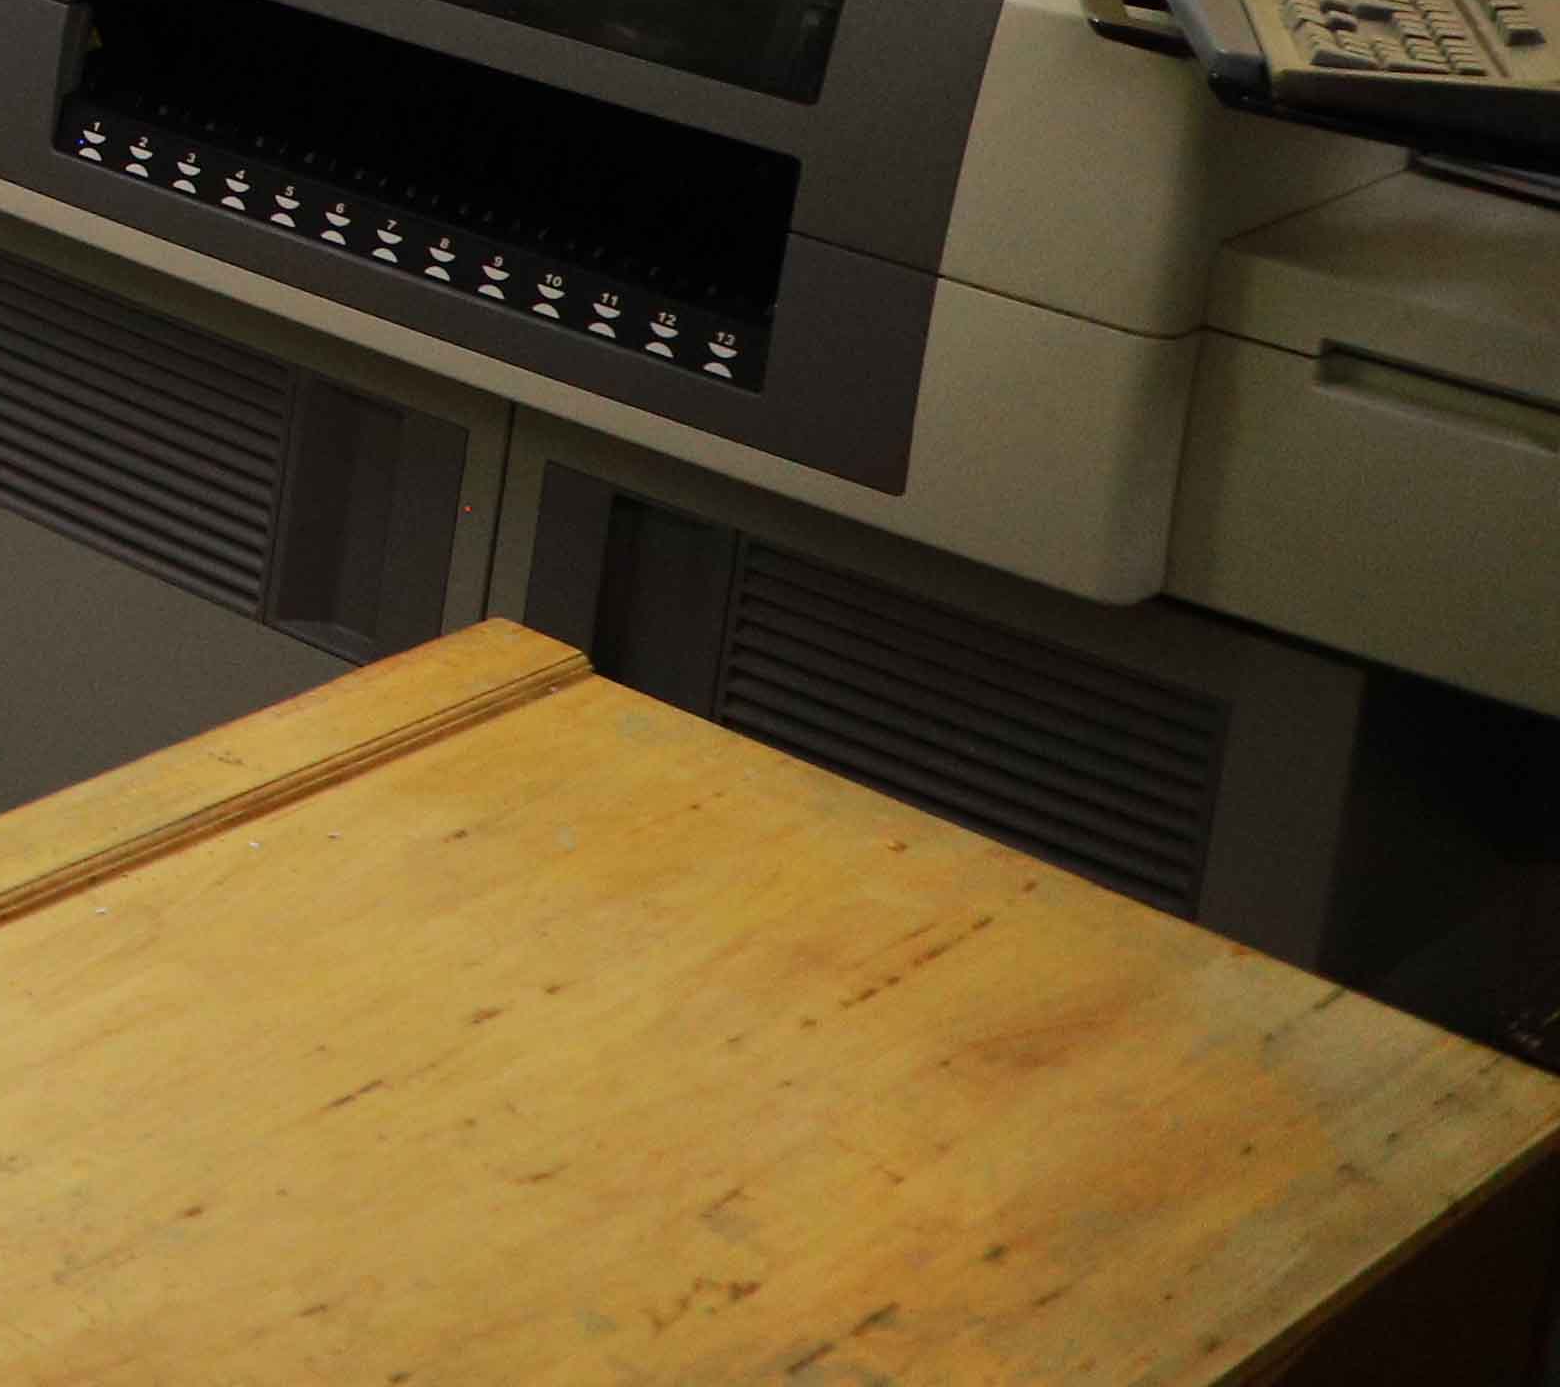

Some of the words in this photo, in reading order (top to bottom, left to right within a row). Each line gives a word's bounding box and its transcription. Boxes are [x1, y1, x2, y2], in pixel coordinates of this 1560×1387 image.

[93, 122, 101, 131] 1
[140, 137, 149, 148] 2
[187, 153, 197, 164] 3
[235, 170, 246, 180] 4
[285, 186, 295, 197] 5
[335, 203, 345, 214] 6
[387, 219, 398, 231] 7
[440, 237, 451, 250] 8
[493, 255, 504, 268] 9
[545, 273, 563, 288] 10
[601, 292, 620, 307] 11
[657, 311, 677, 327] 12
[716, 331, 737, 347] 13
